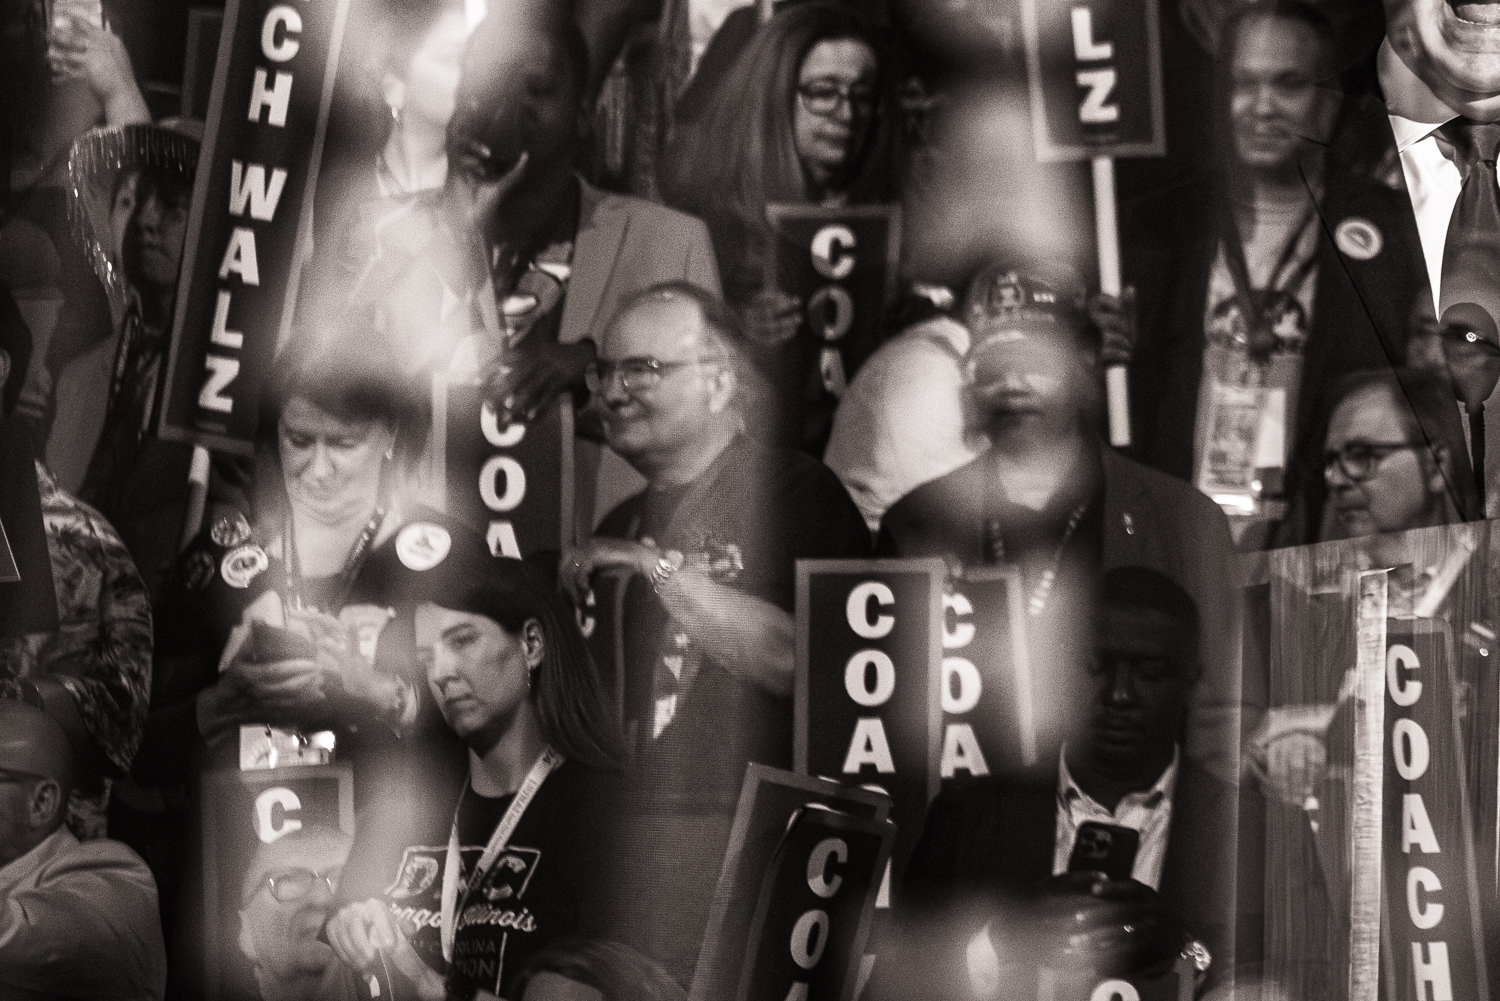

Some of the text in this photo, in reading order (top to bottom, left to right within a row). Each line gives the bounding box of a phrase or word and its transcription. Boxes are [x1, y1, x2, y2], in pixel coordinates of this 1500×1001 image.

[197, 158, 289, 416] WALZ
[842, 580, 897, 797] COA
[1386, 643, 1454, 1001] COACH
